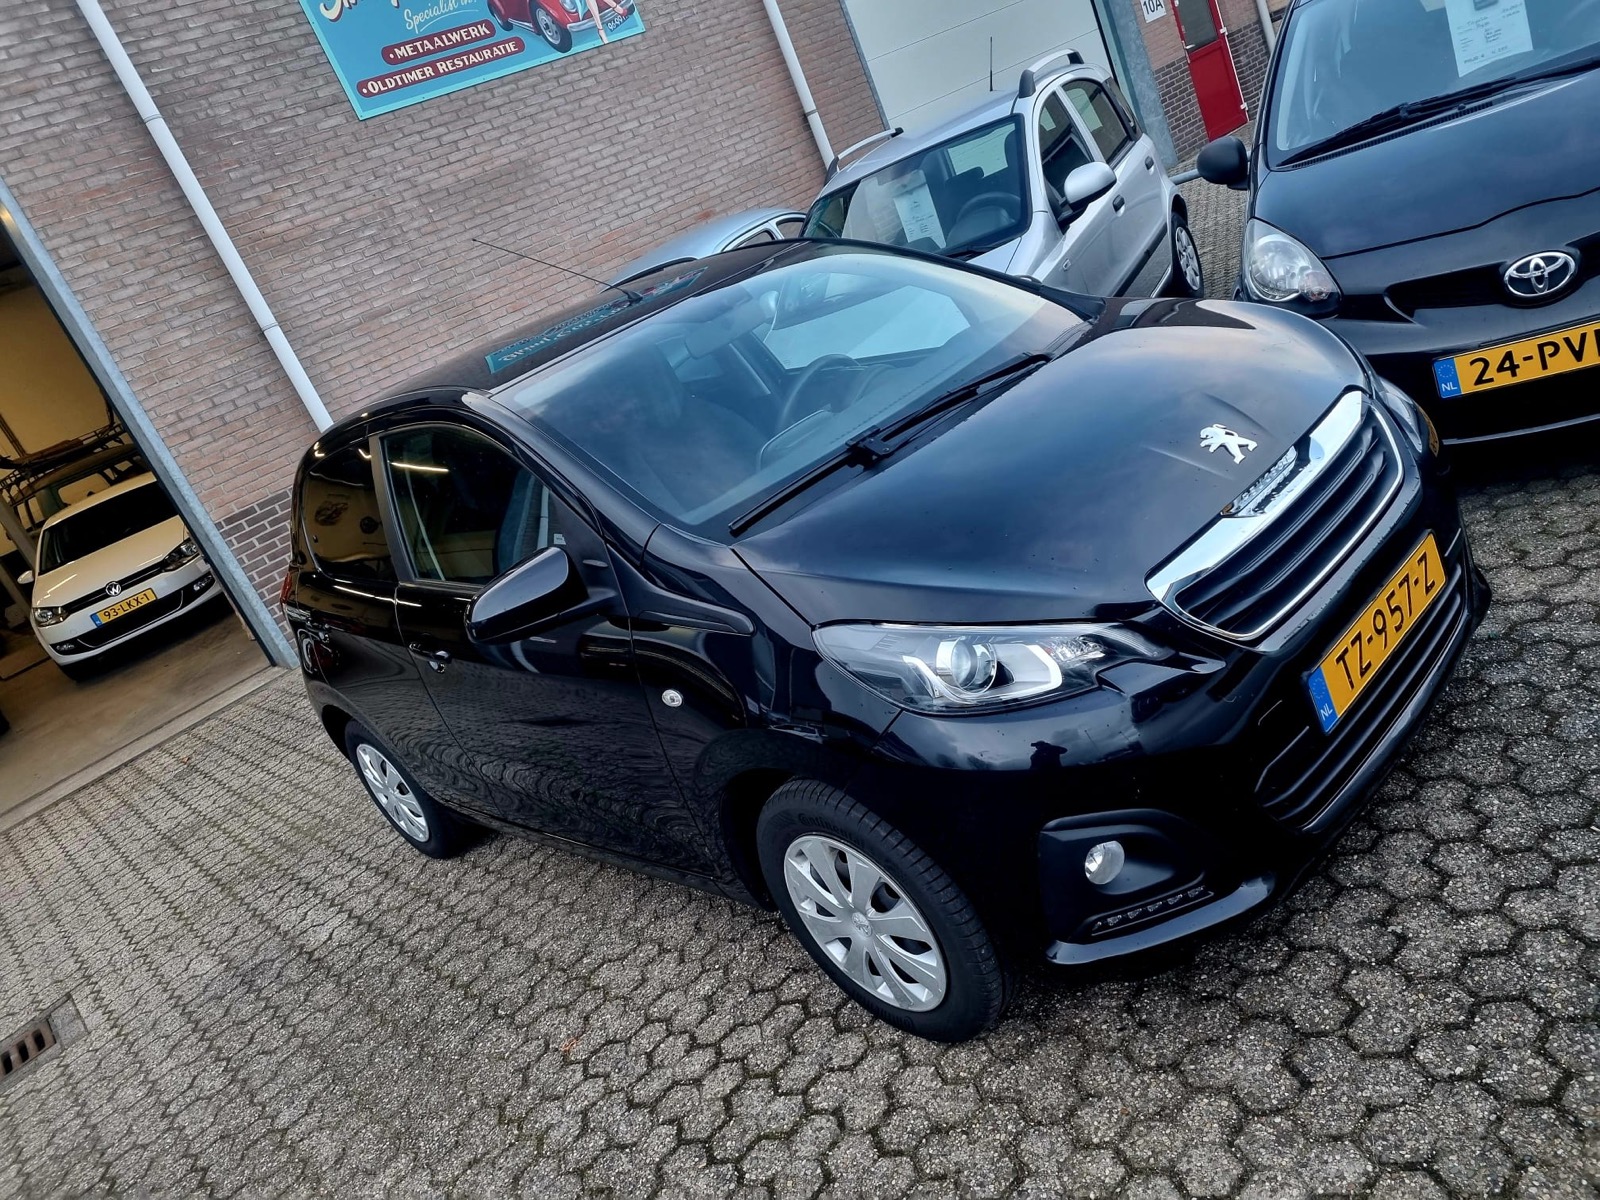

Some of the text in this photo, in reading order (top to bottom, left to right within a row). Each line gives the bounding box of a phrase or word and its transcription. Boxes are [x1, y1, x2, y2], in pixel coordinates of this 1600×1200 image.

[1143, 0, 1164, 14] 10A
[394, 23, 491, 59] METAALWERK
[367, 41, 519, 94] OLDTIMER RESTAURATIE
[1441, 381, 1458, 392] NL
[103, 593, 151, 620] 93-LKX-1
[1334, 550, 1436, 690] TZ-957-Z
[1320, 703, 1334, 721] NL
